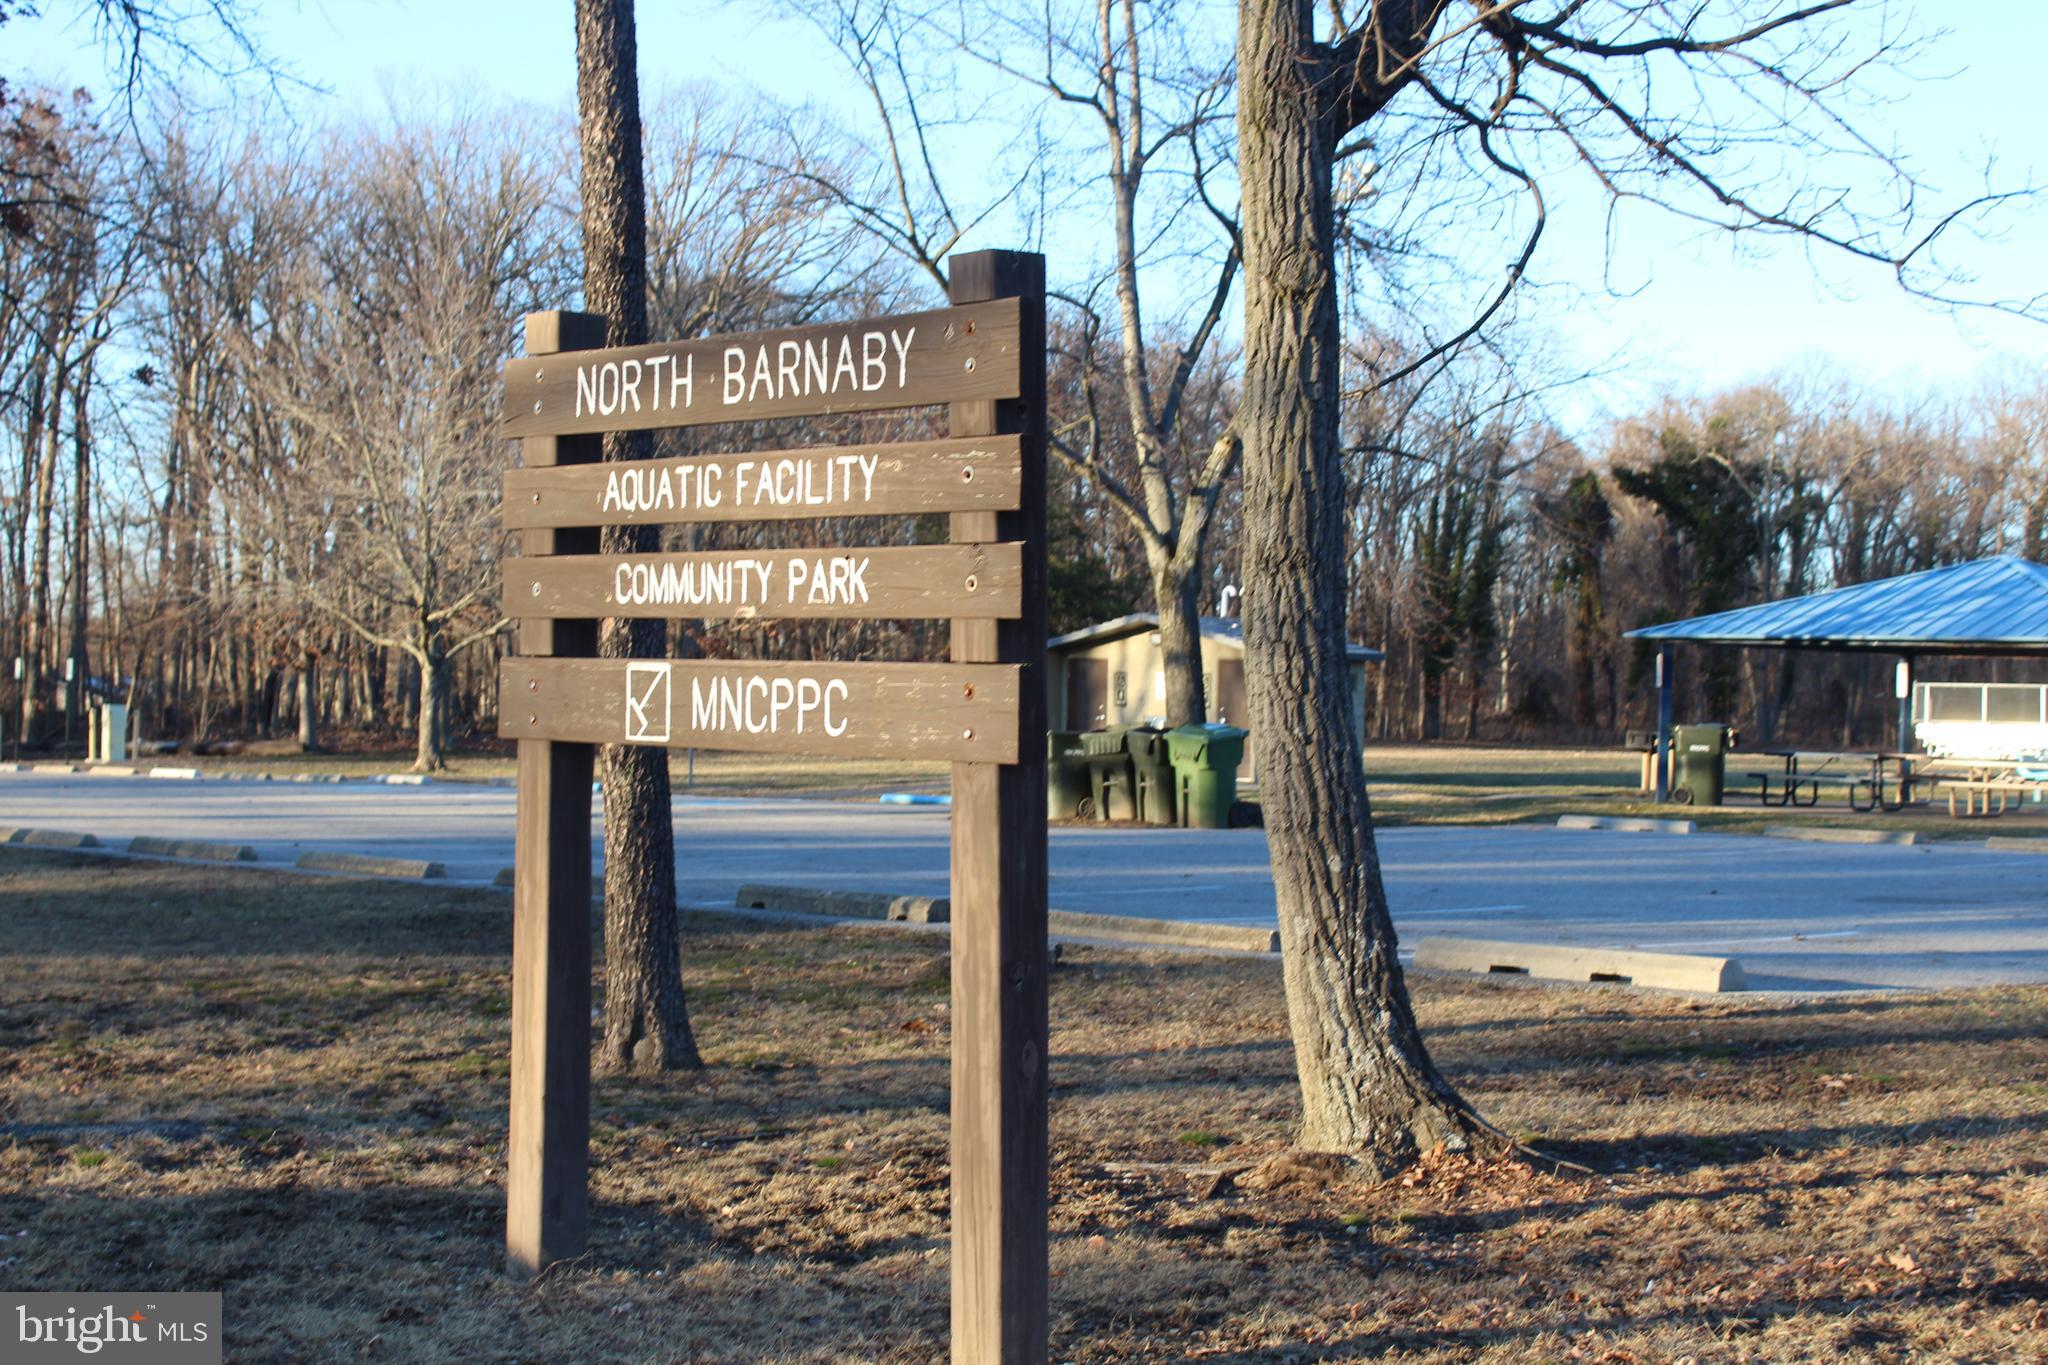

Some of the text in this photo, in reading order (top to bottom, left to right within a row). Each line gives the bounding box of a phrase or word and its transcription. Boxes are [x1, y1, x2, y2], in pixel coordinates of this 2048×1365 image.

[576, 327, 916, 418] NORTH BARNABY
[602, 454, 879, 512] AQUATIC FACILITY
[614, 557, 871, 605] COMMUNITY PARK
[691, 675, 849, 737] MNCPPC
